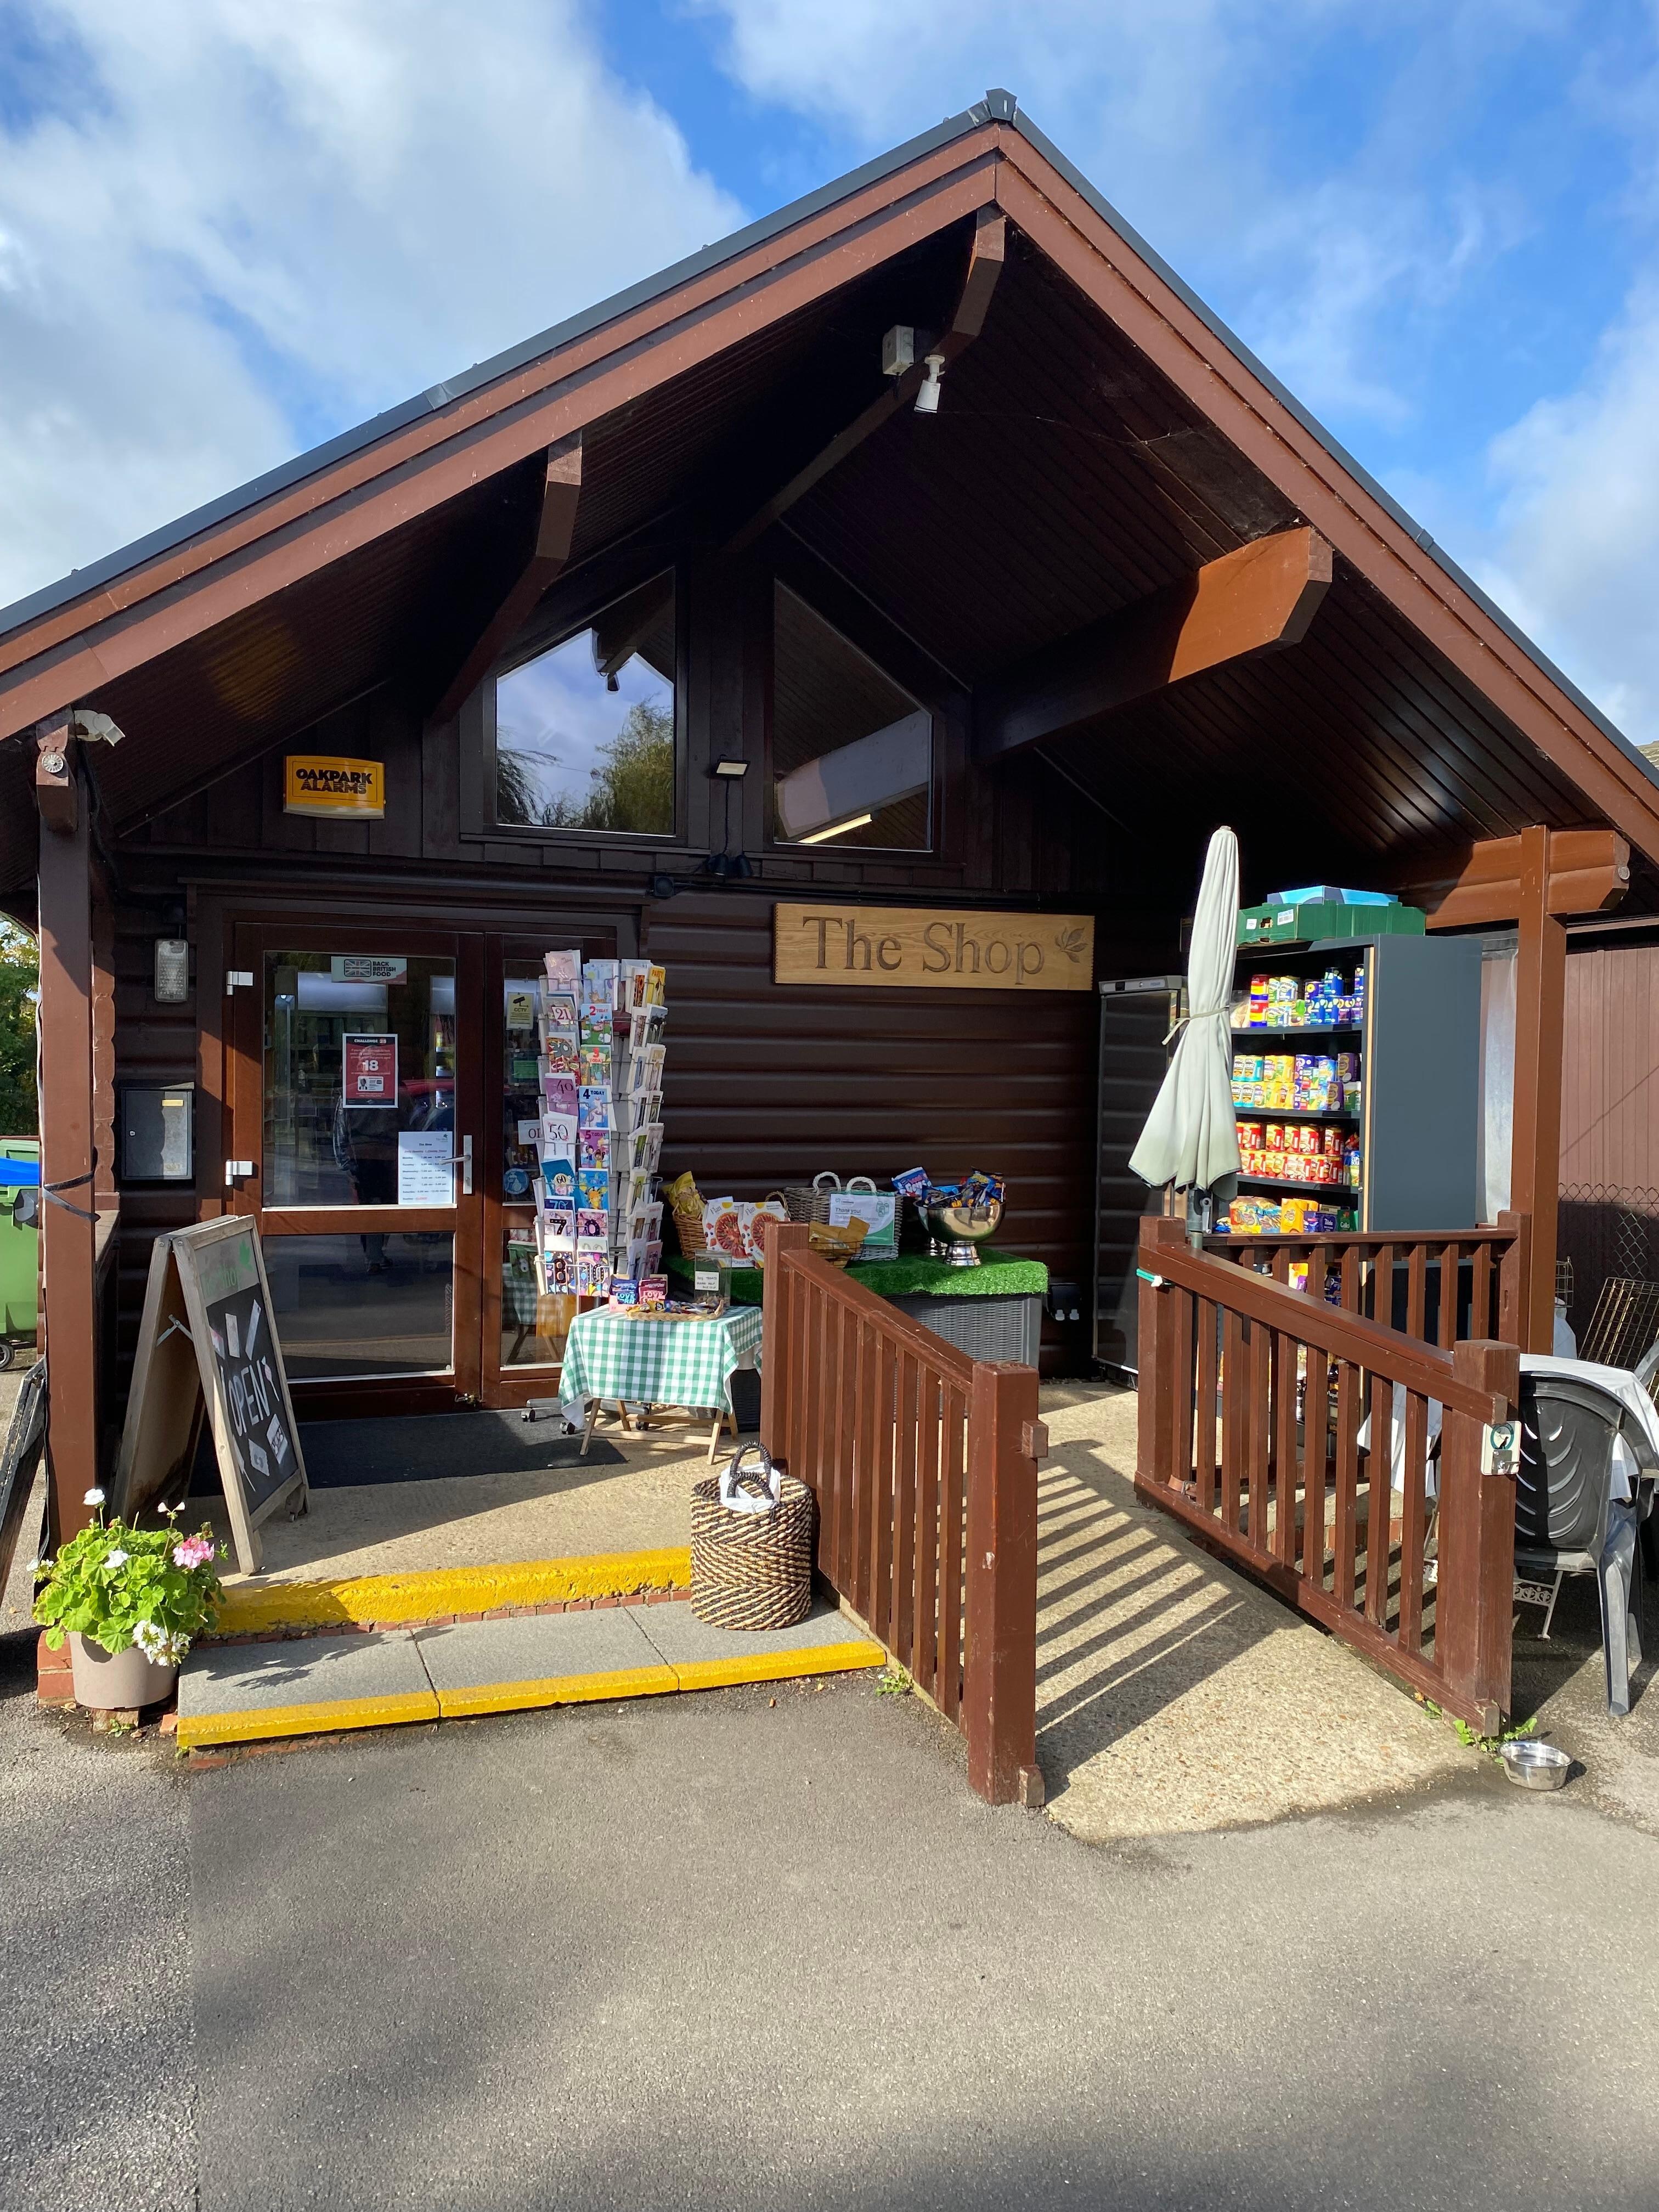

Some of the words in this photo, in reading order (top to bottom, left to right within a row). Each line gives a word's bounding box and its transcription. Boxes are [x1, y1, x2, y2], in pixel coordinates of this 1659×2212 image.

[296, 769, 373, 785] OAKPARK
[301, 780, 366, 794] ALARMS
[803, 916, 902, 970] The
[923, 922, 1044, 985] Shop
[555, 1008, 570, 1020] 21
[589, 1006, 596, 1015] 2
[592, 1047, 600, 1058] 3
[362, 1059, 379, 1071] 18
[556, 1080, 573, 1093] 40
[583, 1088, 590, 1099] 4
[549, 1124, 568, 1141] 50
[585, 1130, 591, 1139] 5
[556, 1175, 566, 1184] 60
[550, 1218, 567, 1235] 7
[554, 1259, 567, 1284] 8
[586, 1263, 605, 1283] 10
[643, 1290, 664, 1299] LOVE
[228, 1359, 270, 1436] OPEN
